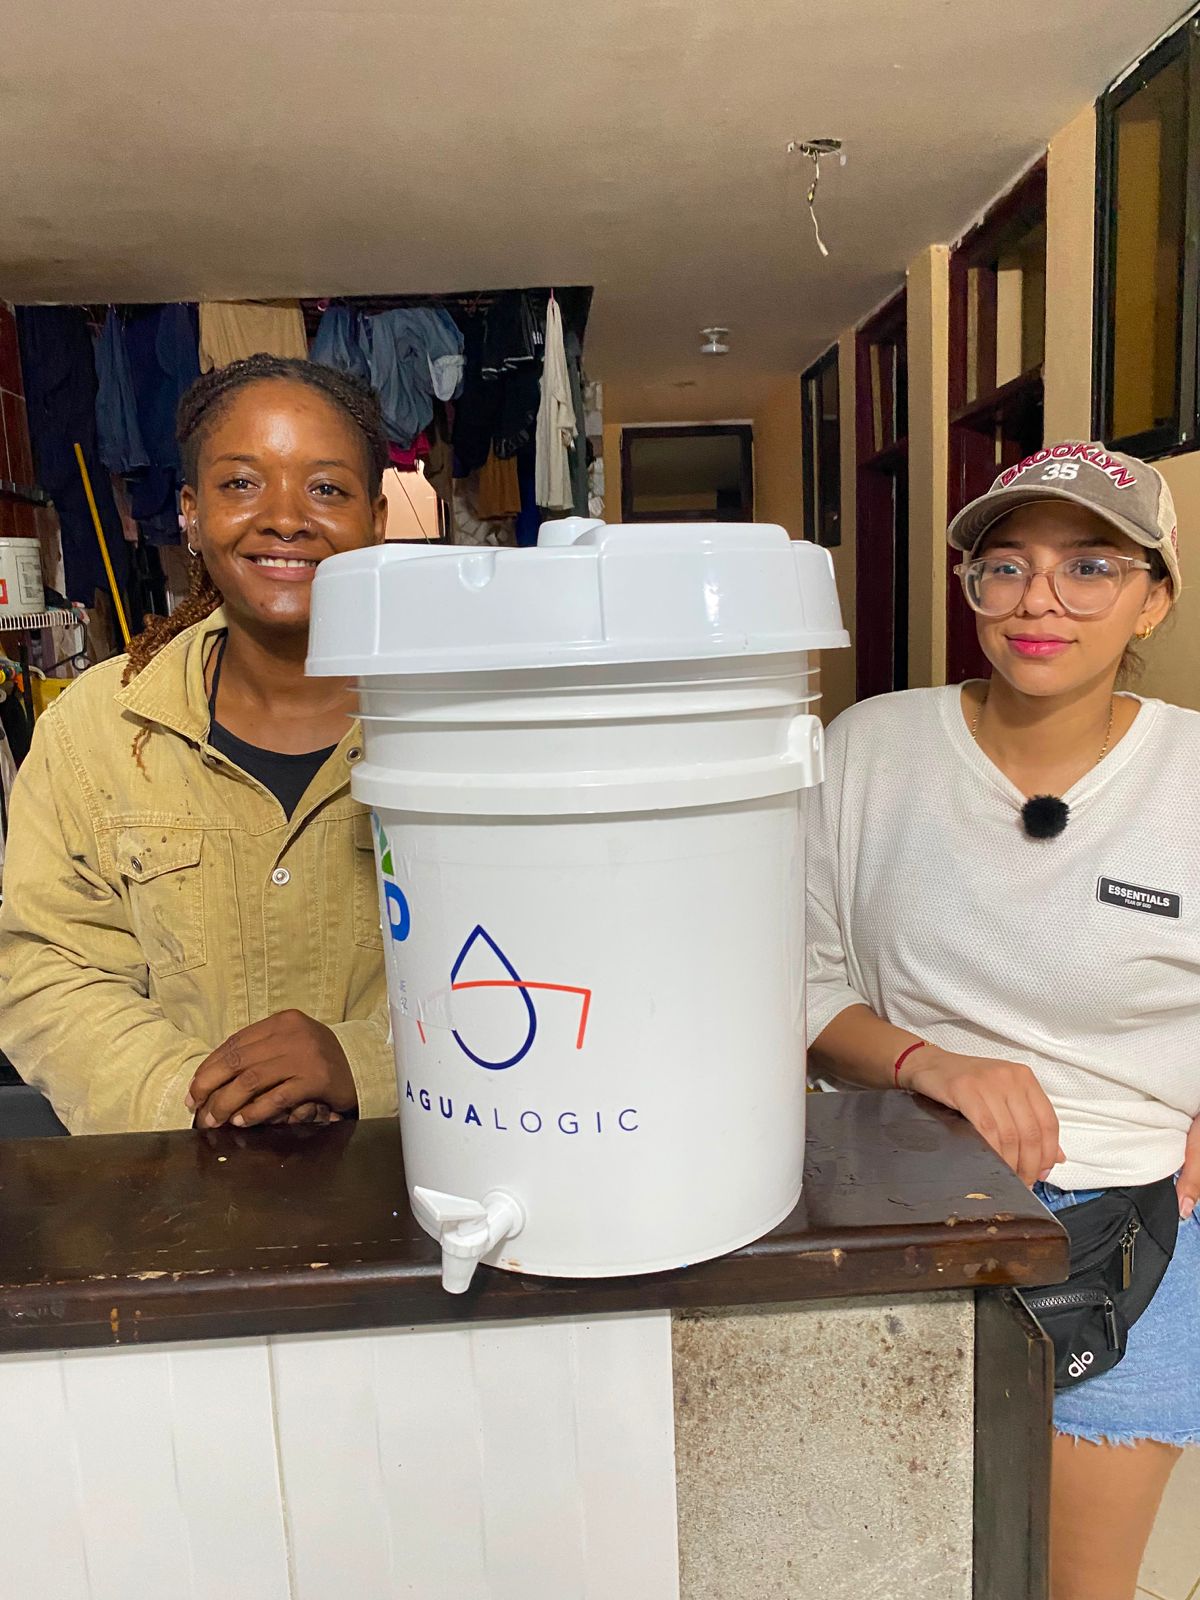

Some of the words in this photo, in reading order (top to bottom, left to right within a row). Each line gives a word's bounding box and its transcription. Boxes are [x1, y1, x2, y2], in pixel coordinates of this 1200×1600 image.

[1000, 443, 1137, 490] BROOKLYN
[1040, 463, 1080, 481] 35
[1108, 884, 1170, 907] ESSENTIALS
[406, 1080, 639, 1134] AGUALOGIC
[1068, 1351, 1094, 1377] alo
